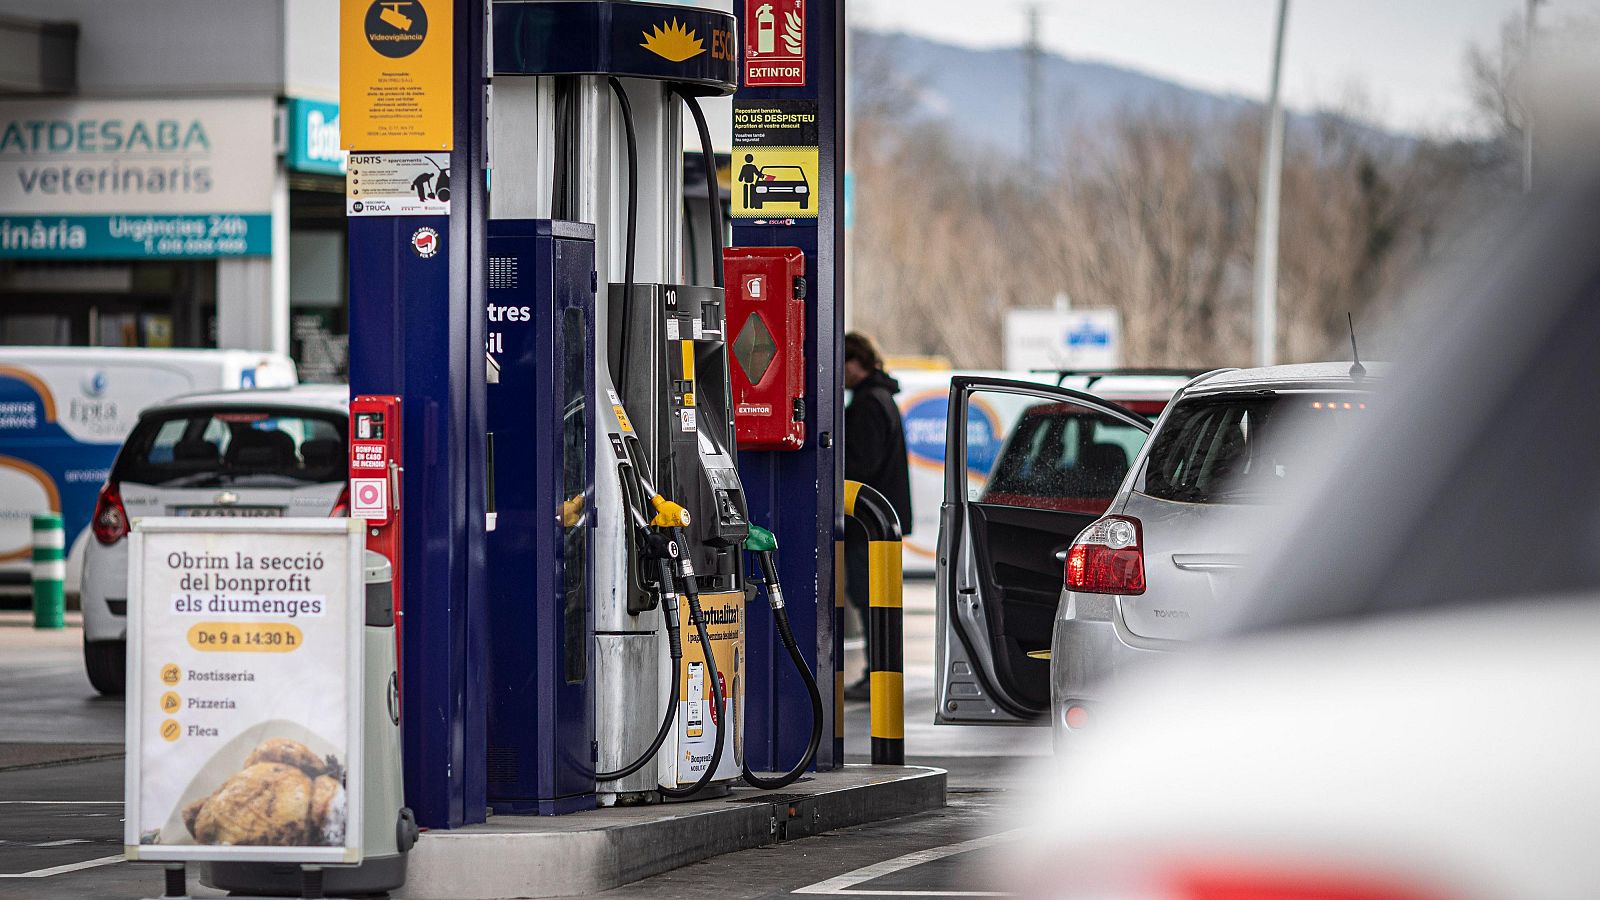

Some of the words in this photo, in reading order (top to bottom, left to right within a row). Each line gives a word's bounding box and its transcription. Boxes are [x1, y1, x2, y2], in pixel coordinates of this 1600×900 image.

[370, 34, 422, 42] Videovigilància
[750, 67, 800, 78] EXTINTOR
[0, 120, 210, 151] ATDESABA
[18, 160, 214, 195] veterinaris
[0, 220, 87, 250] inària
[109, 216, 206, 241] Urgències
[208, 216, 248, 238] 24h
[666, 290, 676, 305] 10
[487, 303, 530, 322] tres
[486, 332, 503, 354] il
[168, 552, 228, 570] Obrim
[236, 552, 254, 570] la
[260, 552, 324, 570] secció
[180, 574, 209, 591] del
[215, 574, 310, 594] bonprofit
[175, 596, 202, 612] els
[208, 596, 321, 617] diumenges
[198, 631, 215, 644] De
[220, 632, 228, 644] 9
[232, 635, 240, 644] a
[246, 632, 282, 645] 14:30
[286, 632, 295, 645] h
[188, 670, 255, 681] Rostisseria
[188, 698, 236, 709] Pizzeria
[188, 726, 218, 736] Fleca
